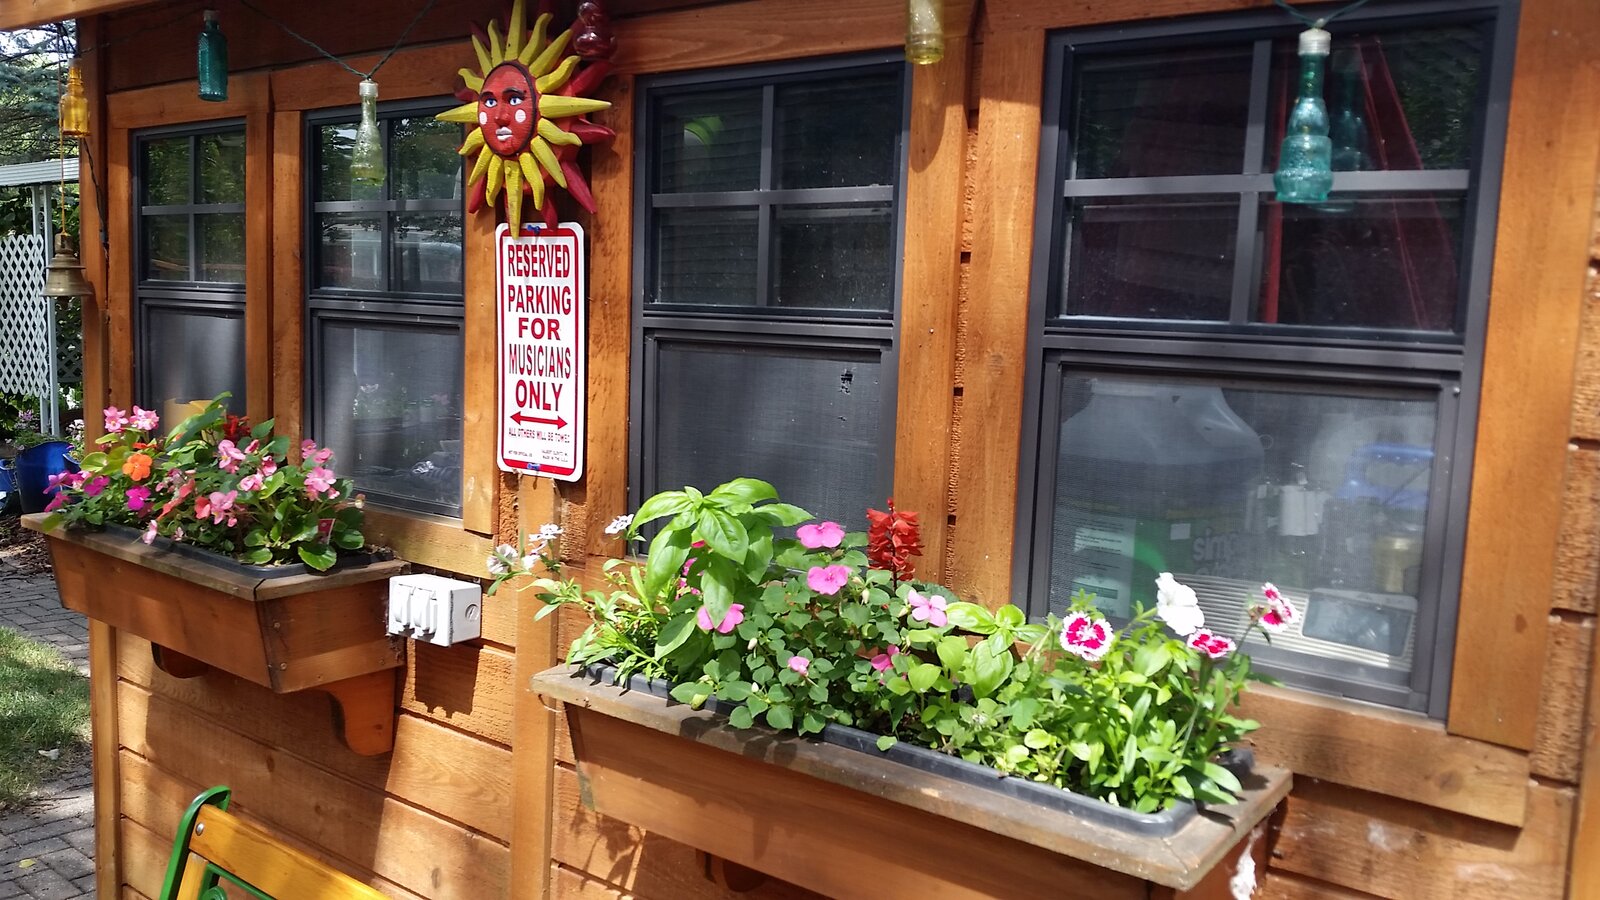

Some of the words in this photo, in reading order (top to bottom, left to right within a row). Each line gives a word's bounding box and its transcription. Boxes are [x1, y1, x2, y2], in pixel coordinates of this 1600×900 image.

[508, 244, 570, 278] RESERVED
[508, 285, 571, 315] PARKING
[518, 317, 561, 341] FOR
[509, 343, 571, 379] MUSICIANS
[515, 379, 563, 412] ONLY
